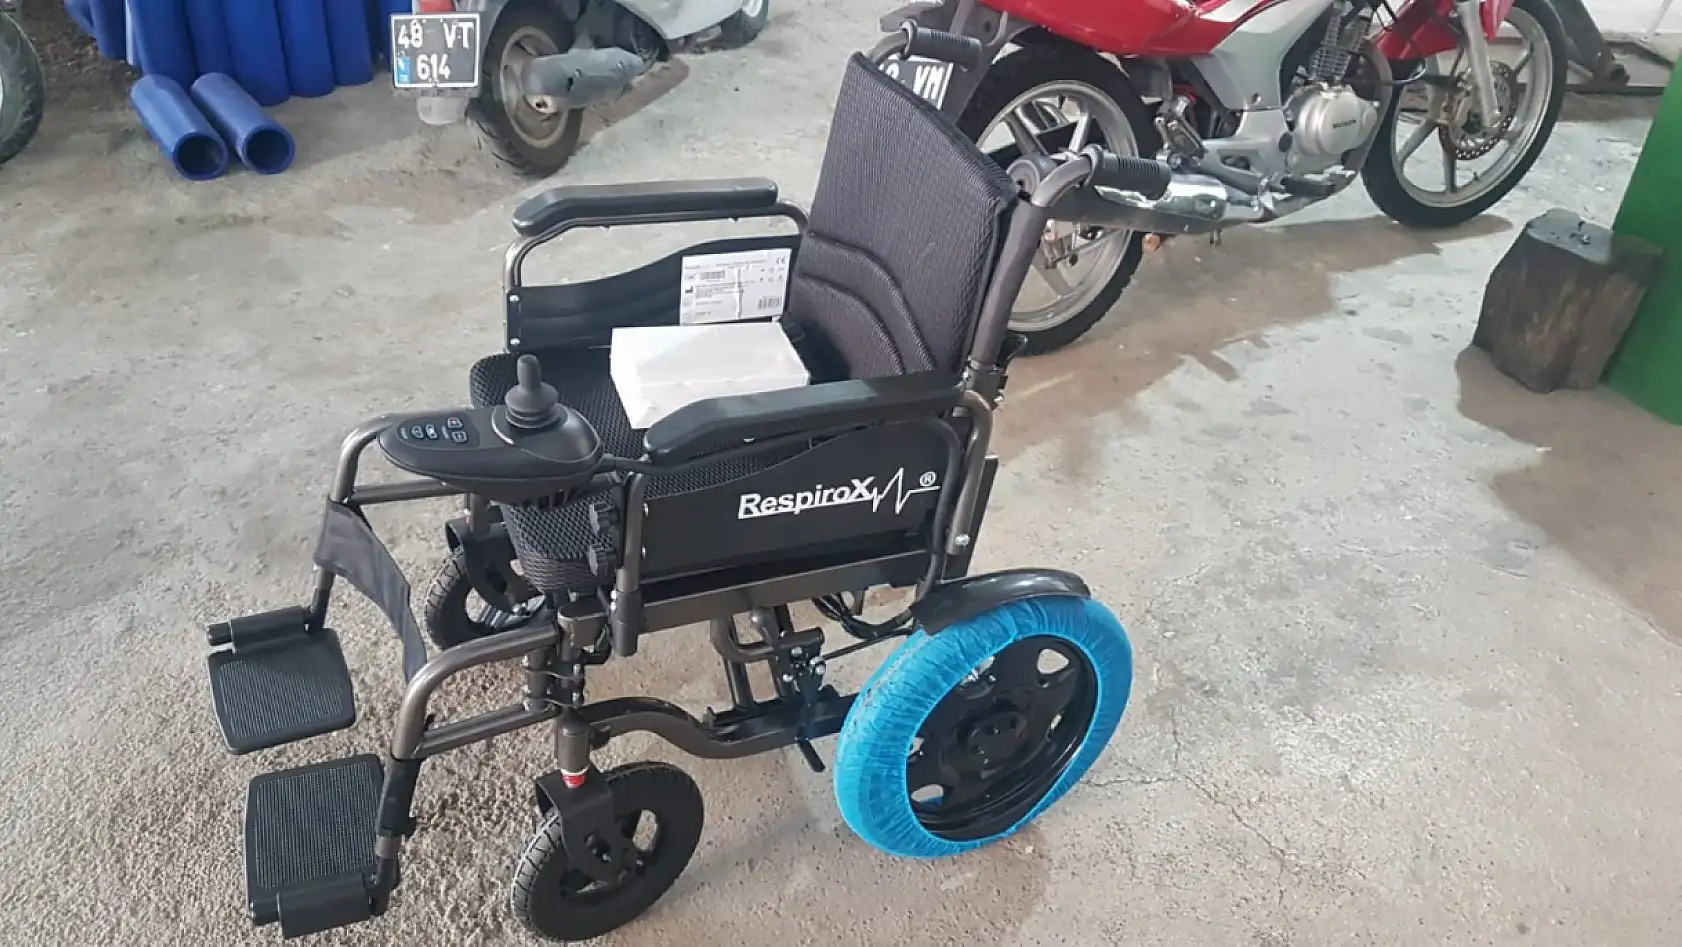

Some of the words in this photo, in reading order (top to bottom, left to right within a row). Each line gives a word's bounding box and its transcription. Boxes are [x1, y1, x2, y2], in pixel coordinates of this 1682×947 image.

[397, 20, 424, 49] 48
[443, 21, 475, 50] VT
[416, 53, 451, 80] 614
[738, 475, 876, 517] RespiroX
